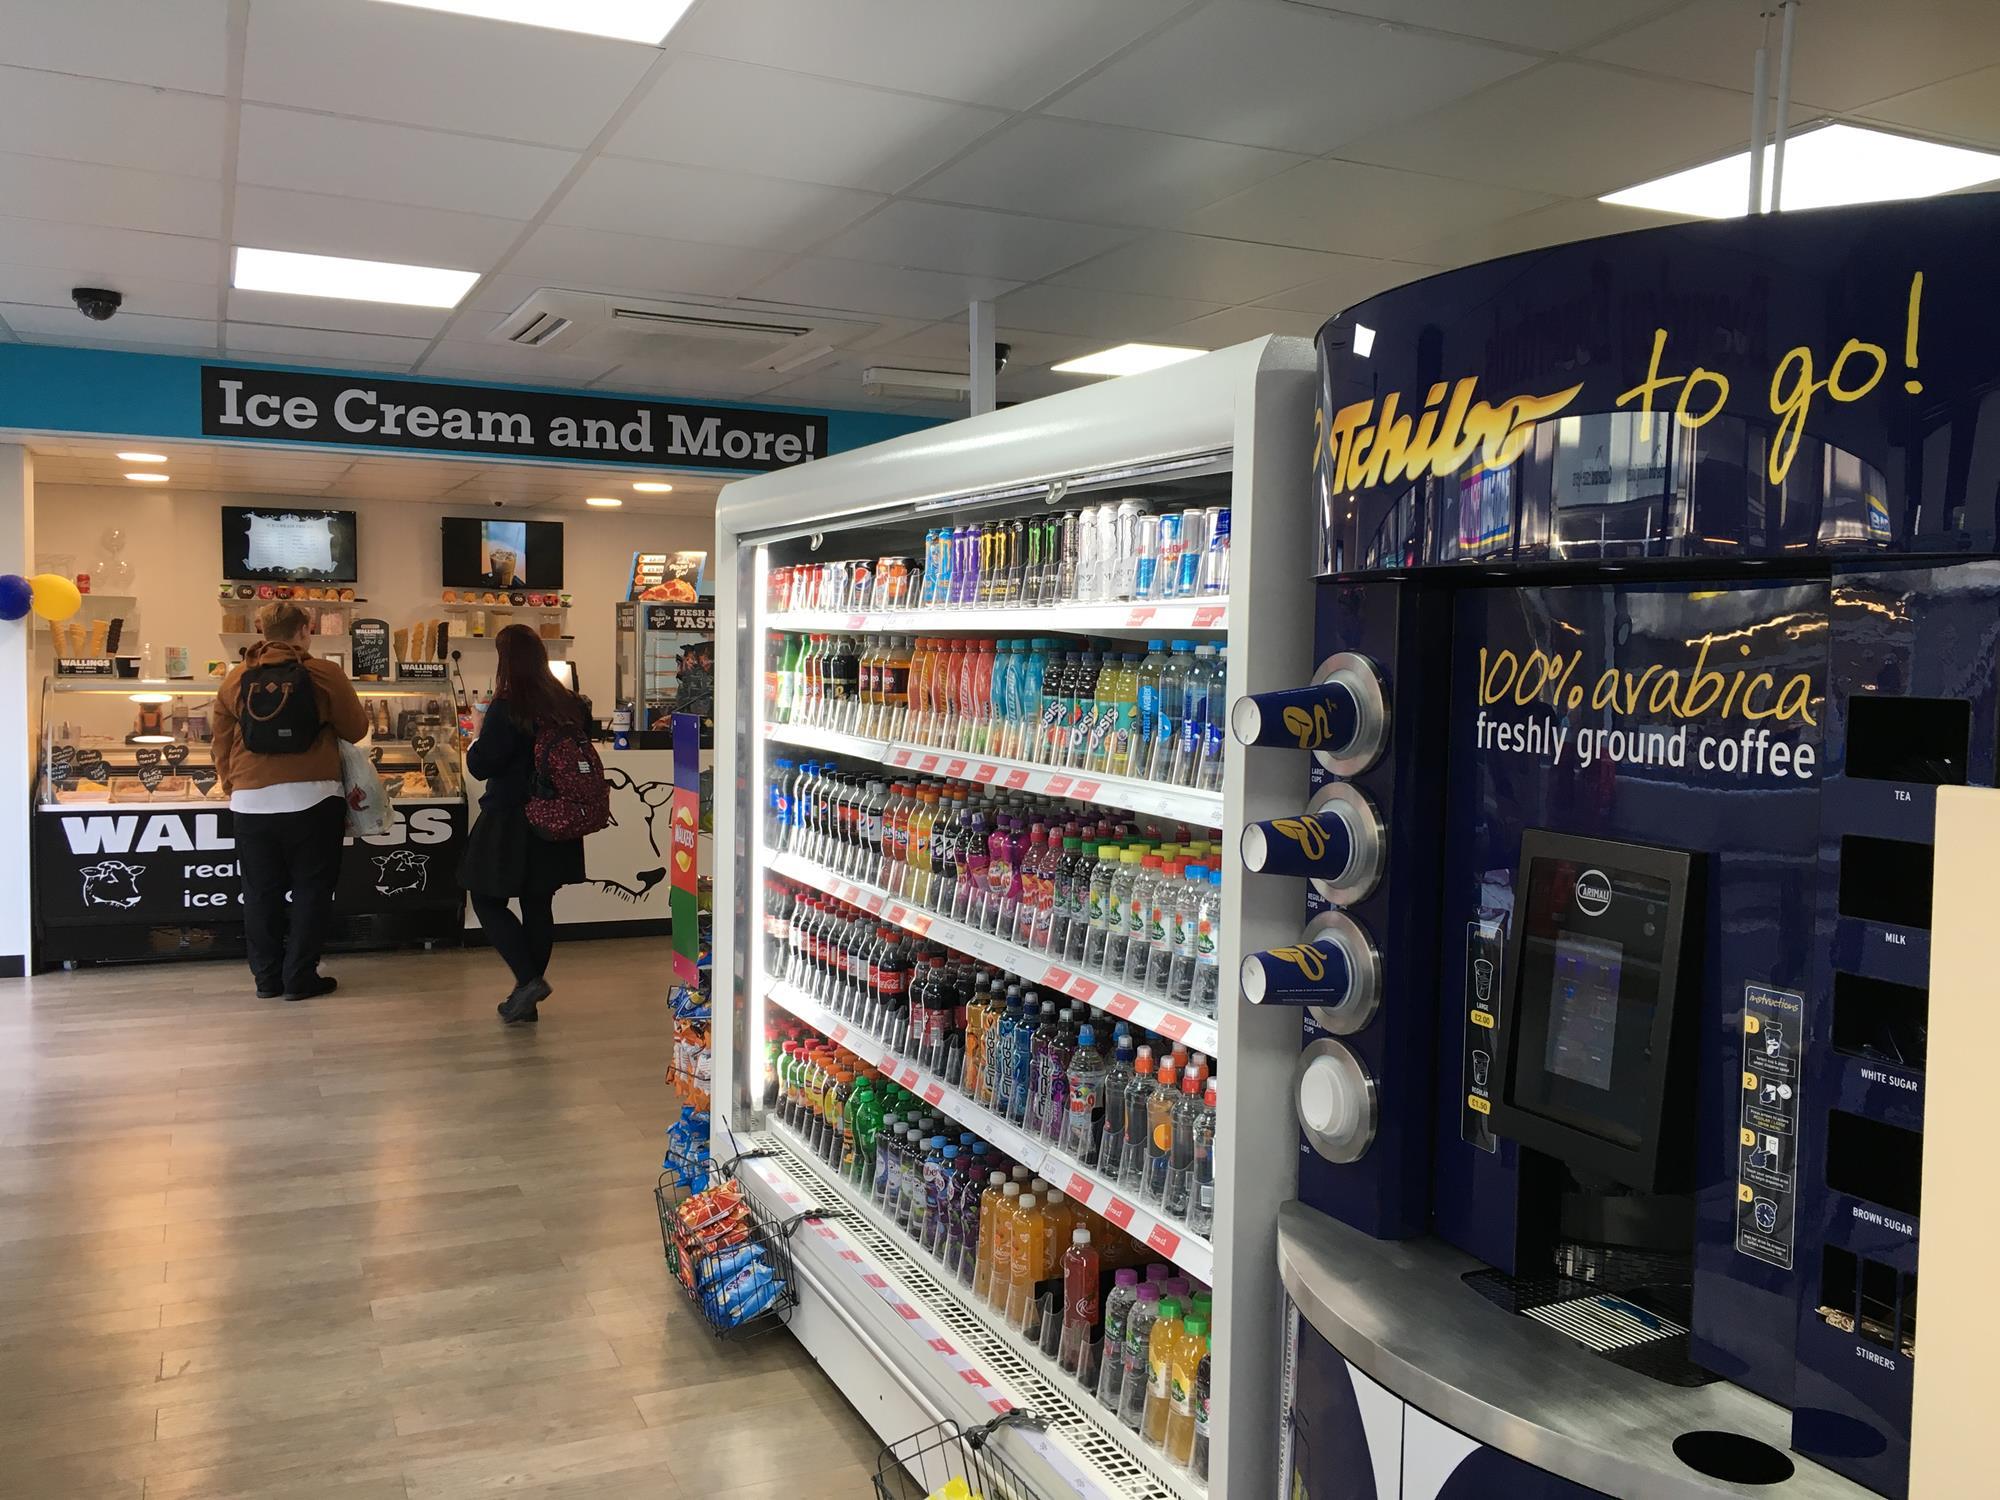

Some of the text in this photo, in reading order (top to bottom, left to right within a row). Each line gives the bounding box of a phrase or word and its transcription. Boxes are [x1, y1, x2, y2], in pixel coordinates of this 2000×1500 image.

[1330, 271, 1923, 495] Tchibo to go!
[218, 380, 816, 463] Ice Cream and More!
[673, 608, 716, 616] FRESH H
[673, 616, 716, 629] TAST
[61, 659, 110, 667] WALLINGS
[1477, 645, 1817, 727] 100% arabica
[1476, 711, 1815, 779] freshly ground coffee
[1311, 767, 1325, 776] LARGE
[1311, 775, 1322, 784] CUPS
[1895, 790, 1911, 802] TEA
[674, 823, 695, 849] WALKERS
[184, 859, 241, 880] real
[184, 889, 231, 909] ice
[1577, 883, 1610, 903] CARIMALI
[1307, 900, 1319, 910] CUPS
[1885, 932, 1906, 946] MILK
[1474, 1013, 1491, 1025] £2.00
[1750, 1021, 1754, 1030] 1
[1303, 1025, 1315, 1035] CUPS
[1747, 1077, 1753, 1086] 2
[1861, 1068, 1918, 1093] WHITE SUGAR
[1471, 1098, 1488, 1111] £1.50
[1745, 1133, 1750, 1143] 3
[1742, 1190, 1748, 1199] 4
[1853, 1206, 1913, 1236] BROWN SUGAR
[1856, 1346, 1896, 1371] STIRRERS
